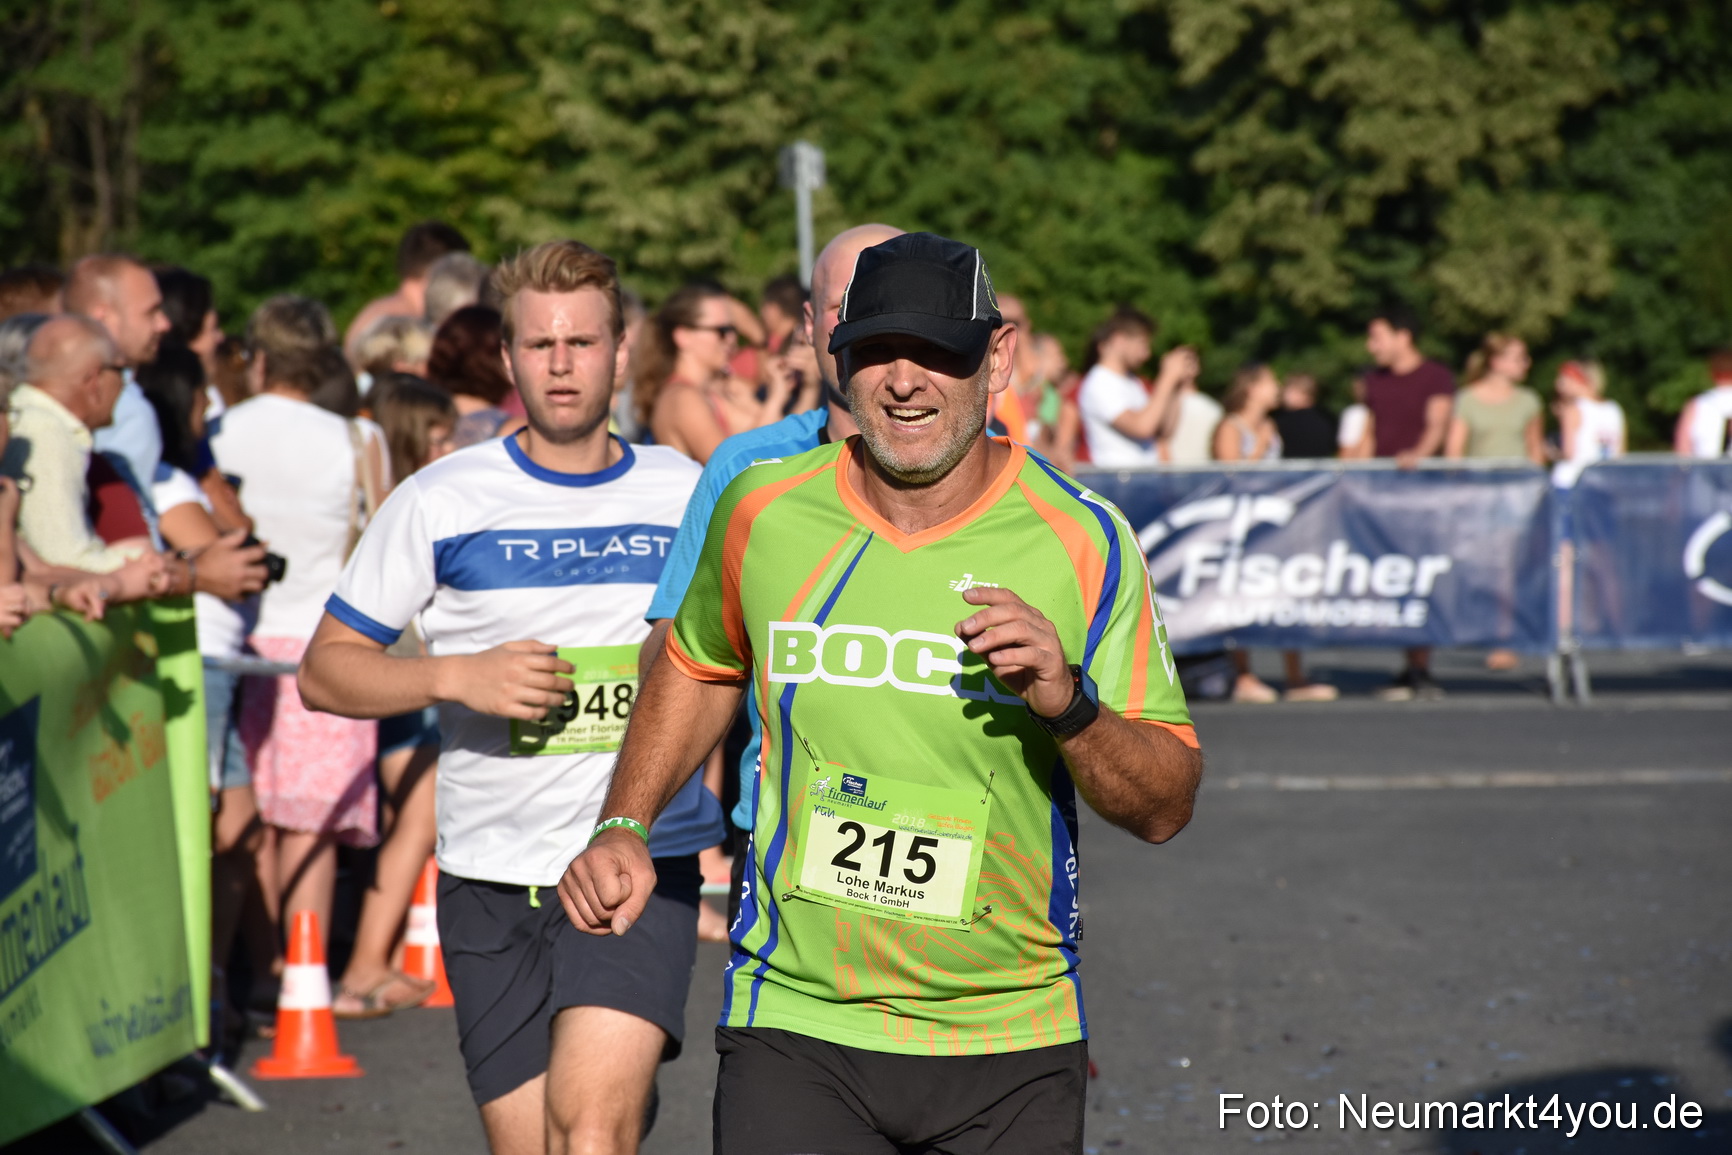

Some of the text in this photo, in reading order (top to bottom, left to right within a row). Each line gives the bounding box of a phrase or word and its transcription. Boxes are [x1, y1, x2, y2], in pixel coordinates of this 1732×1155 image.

[497, 534, 672, 561] TR PLAST
[1178, 540, 1453, 598] Fischer
[1205, 600, 1428, 628] AUTOMOBILE
[538, 683, 633, 723] 948
[828, 787, 888, 811] firmenlauf
[892, 813, 926, 829] 2018
[831, 821, 939, 885] 215
[836, 871, 925, 900] Lohe Markus
[846, 888, 870, 901] Bock
[873, 894, 877, 903] 1
[880, 896, 910, 909] GmbH
